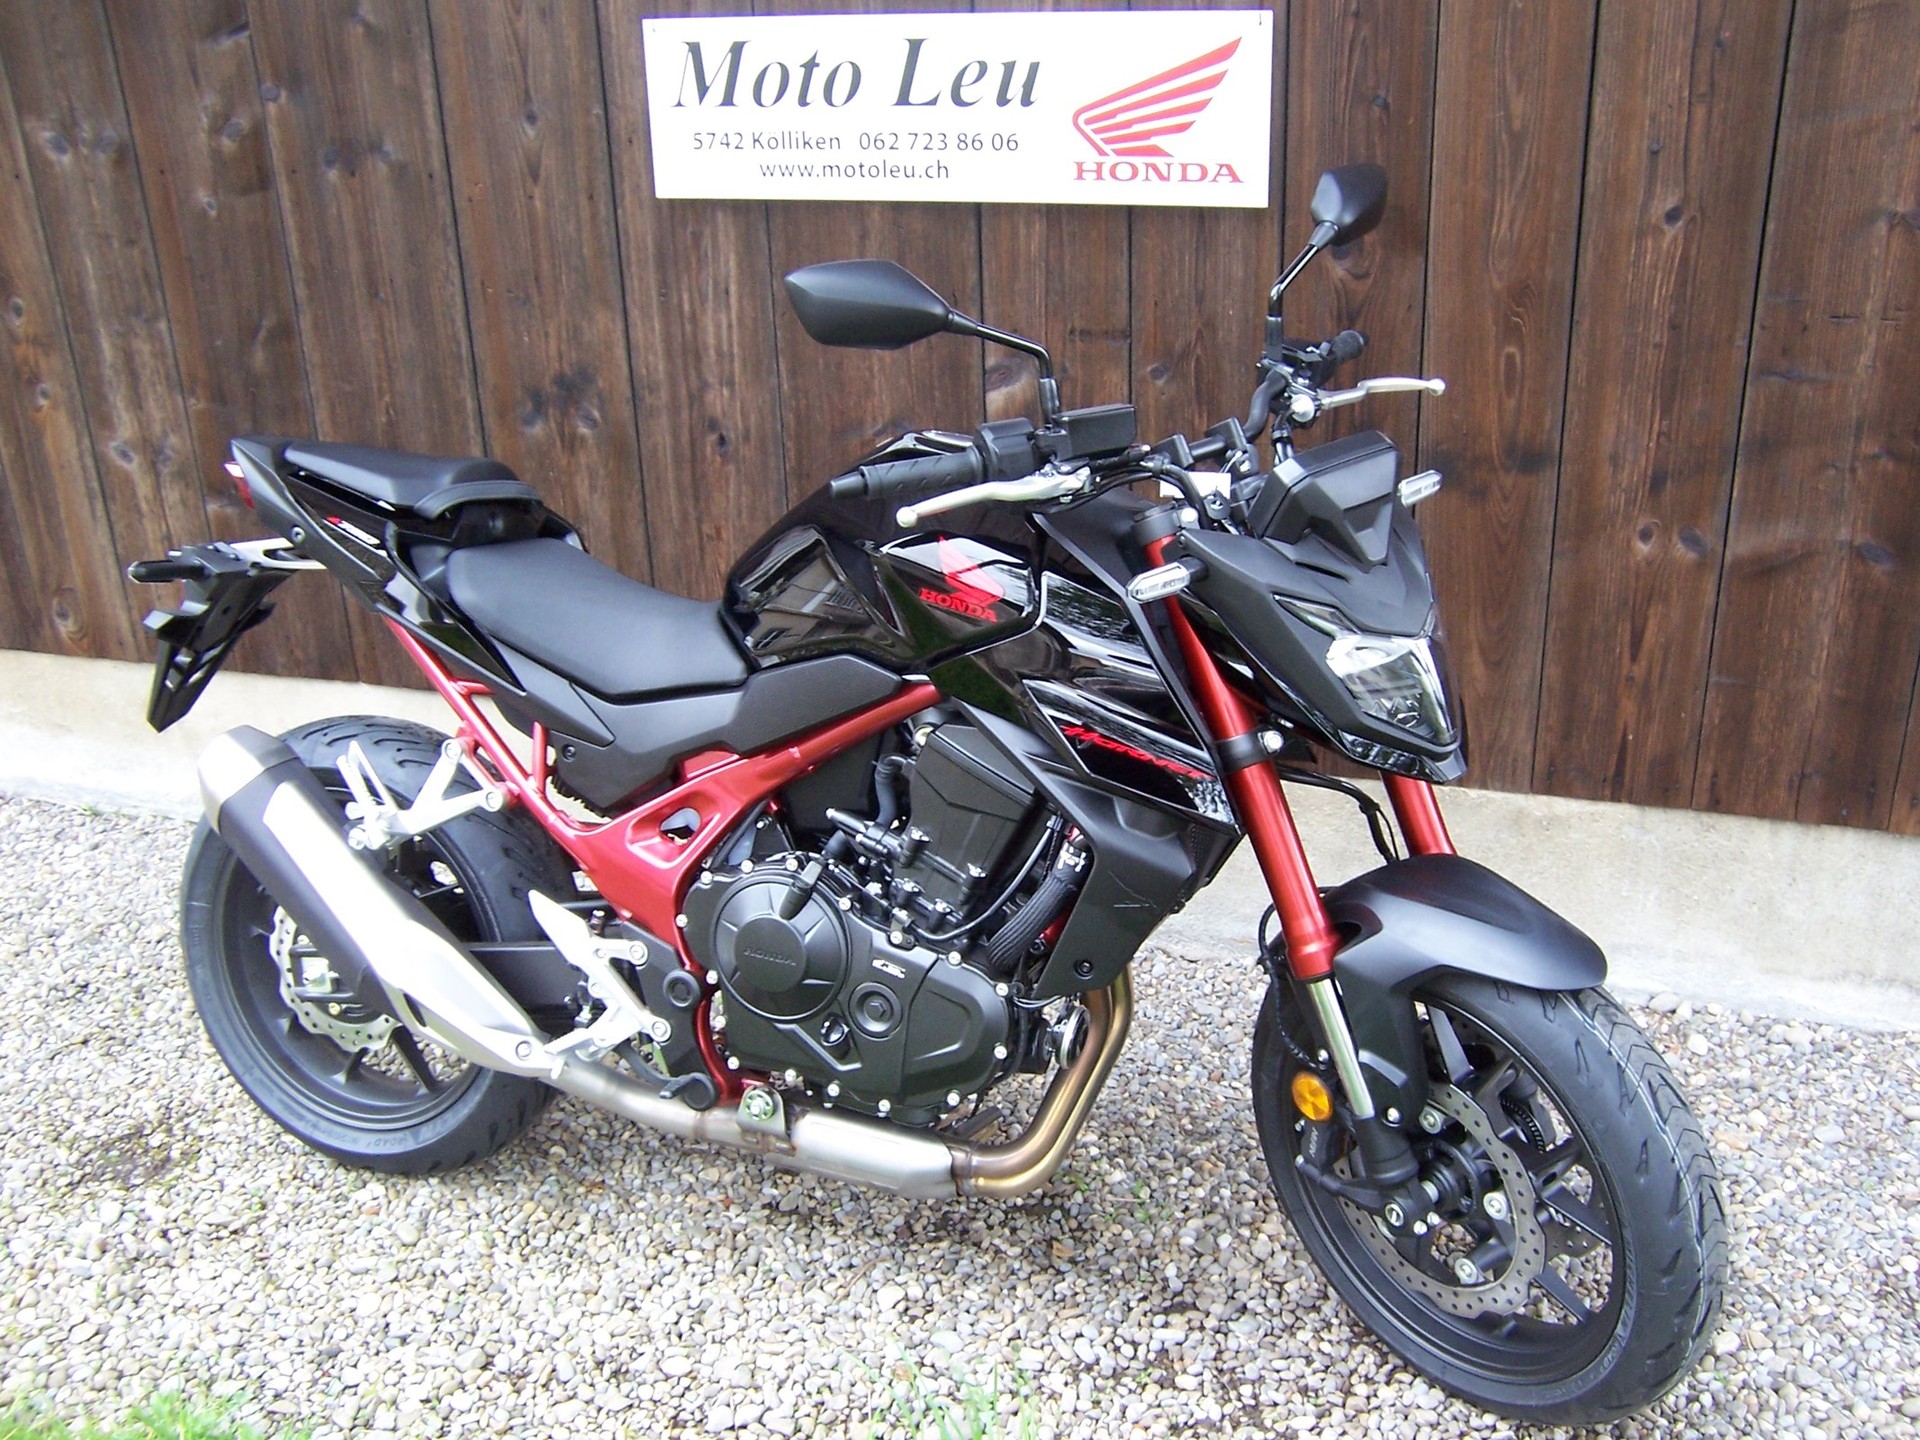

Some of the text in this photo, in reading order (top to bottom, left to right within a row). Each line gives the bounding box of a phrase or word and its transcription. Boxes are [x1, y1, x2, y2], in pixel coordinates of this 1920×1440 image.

[671, 37, 1041, 108] Moto Leu
[693, 132, 744, 150] 5742
[859, 132, 899, 150] 062
[908, 132, 948, 150] 723
[957, 132, 983, 151] 86
[992, 133, 1018, 151] 06
[760, 159, 949, 179] www.motoleu.ch
[1073, 160, 1244, 183] HONDA
[919, 587, 998, 624] HONDA
